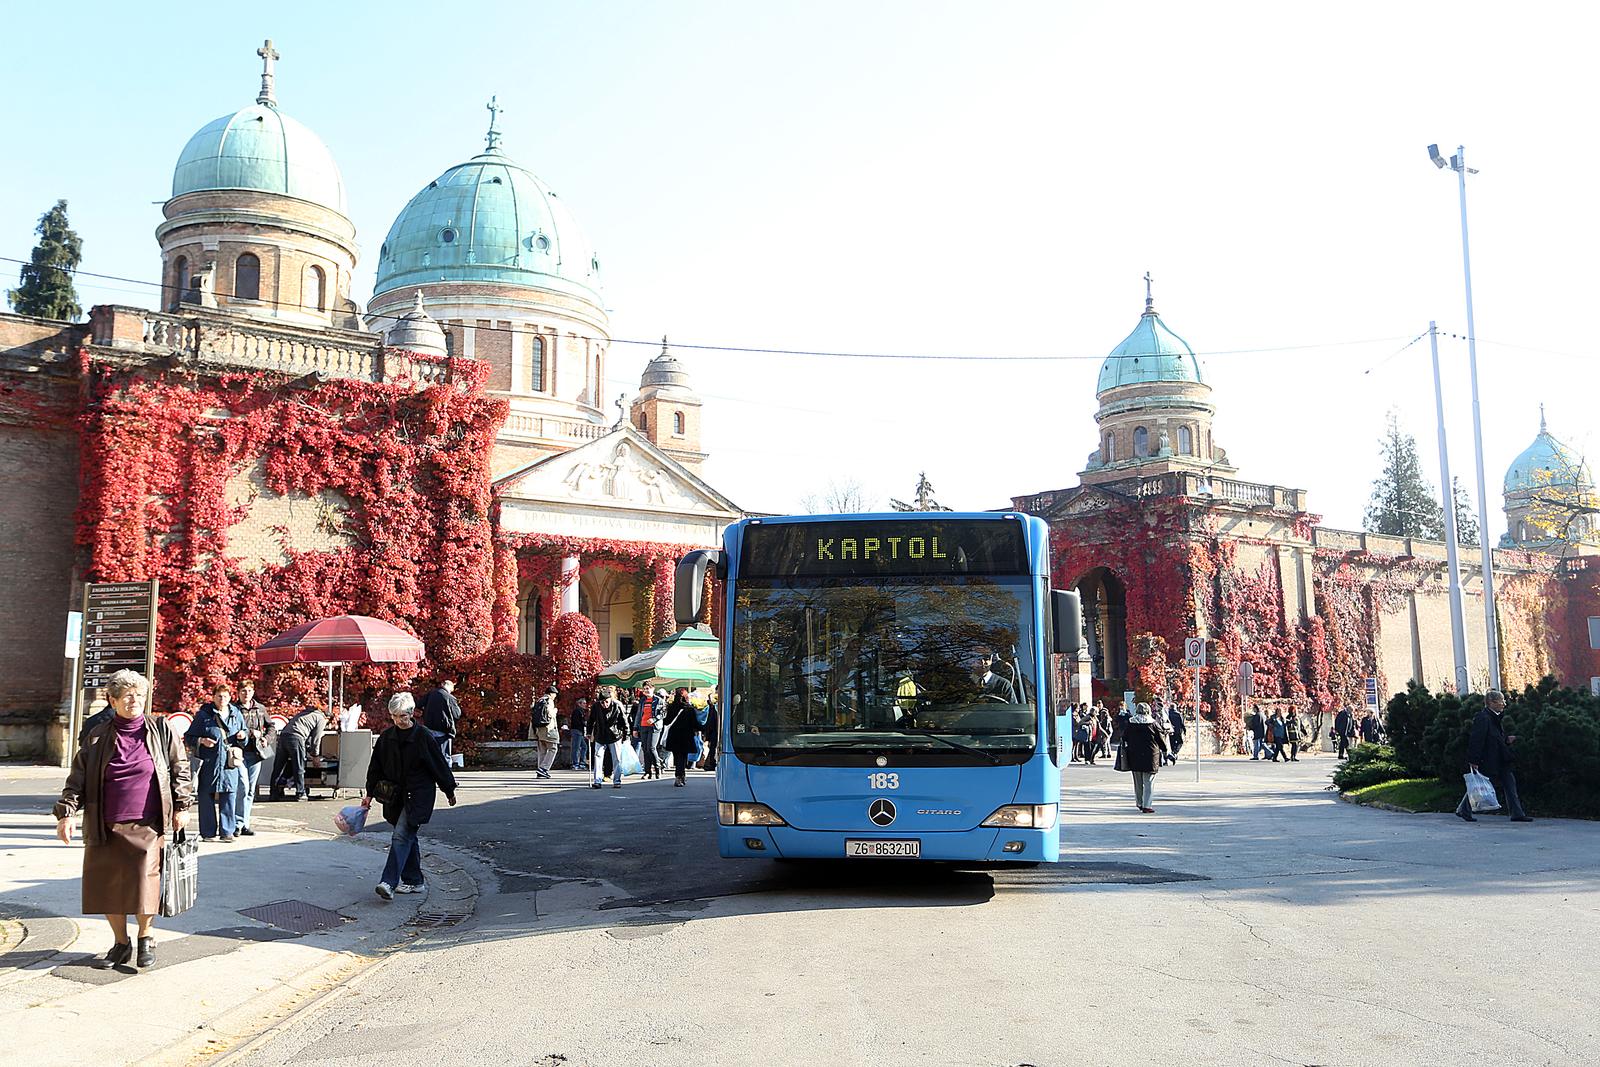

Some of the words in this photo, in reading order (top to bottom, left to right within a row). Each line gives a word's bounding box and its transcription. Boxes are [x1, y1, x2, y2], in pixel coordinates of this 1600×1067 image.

[818, 537, 947, 560] KAPTOL
[1188, 658, 1202, 666] ZONA
[867, 772, 900, 789] 183
[854, 843, 868, 855] ZG
[875, 843, 918, 855] 8632-DU
